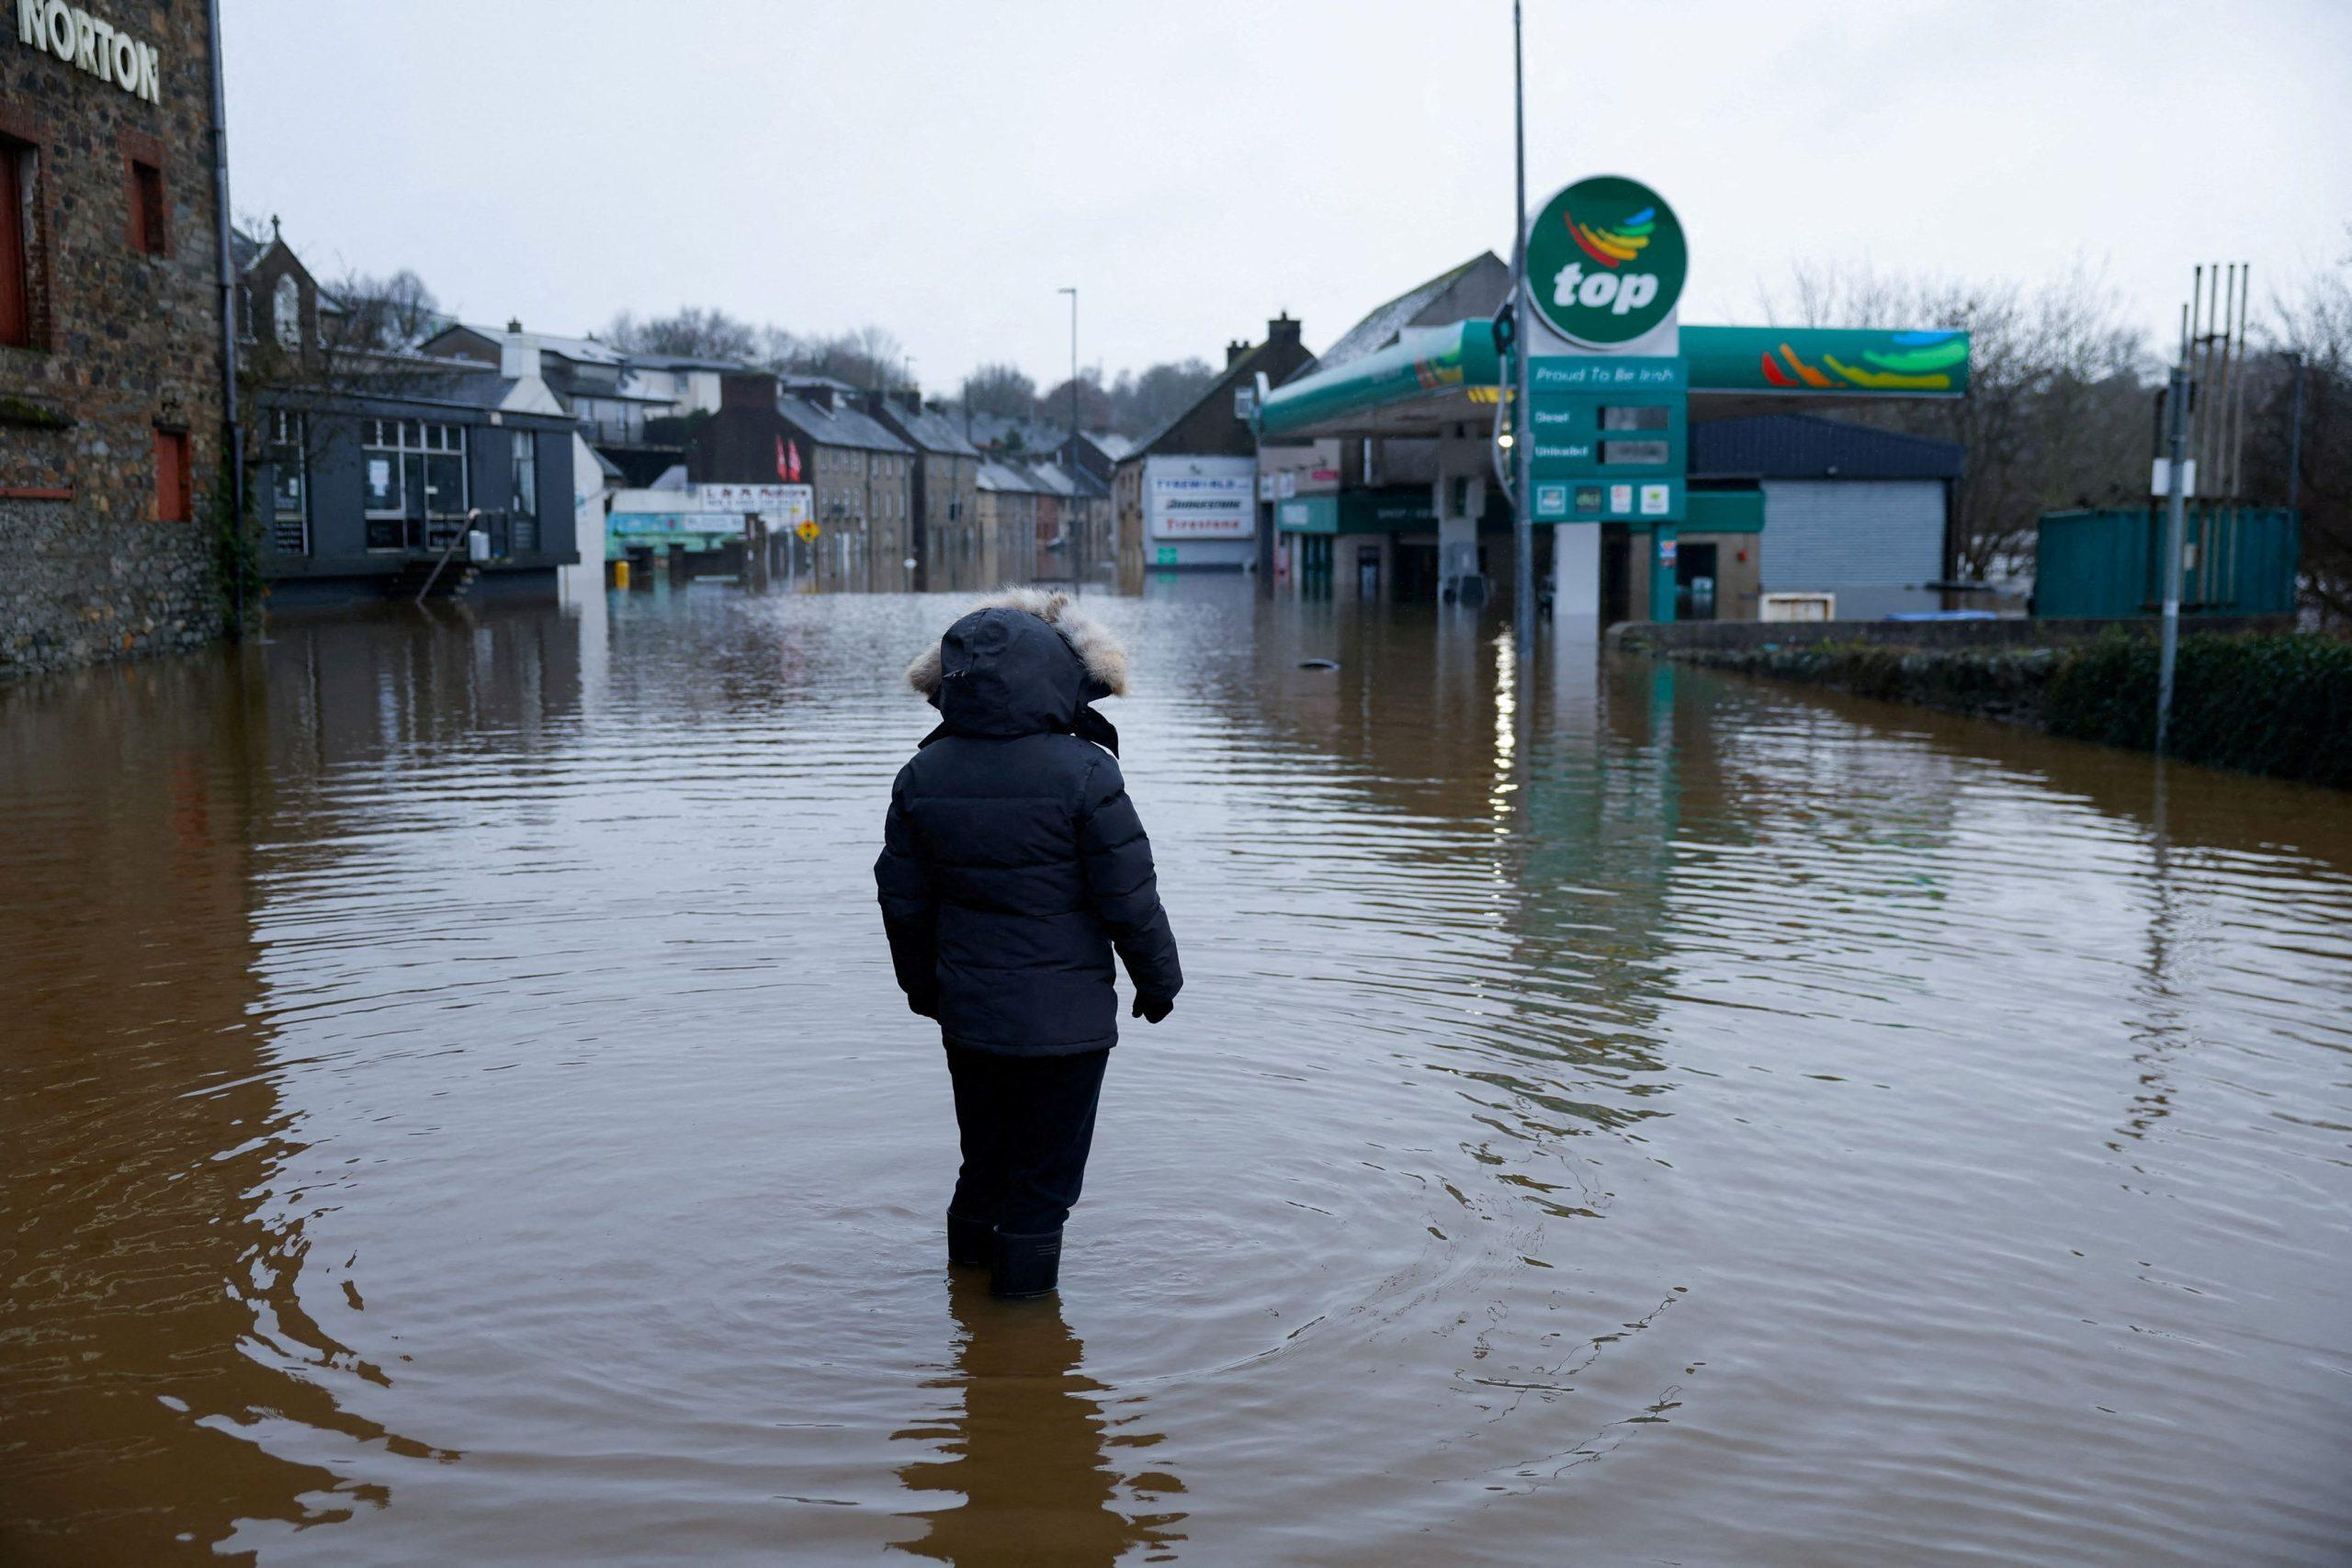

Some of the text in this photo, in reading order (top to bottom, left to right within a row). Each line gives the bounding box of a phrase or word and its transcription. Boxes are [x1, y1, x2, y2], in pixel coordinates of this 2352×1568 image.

[17, 0, 160, 106] NORTON
[1553, 262, 1658, 315] top
[1535, 367, 1587, 383] Proud
[1592, 367, 1611, 383] To
[1614, 367, 1634, 382] Be
